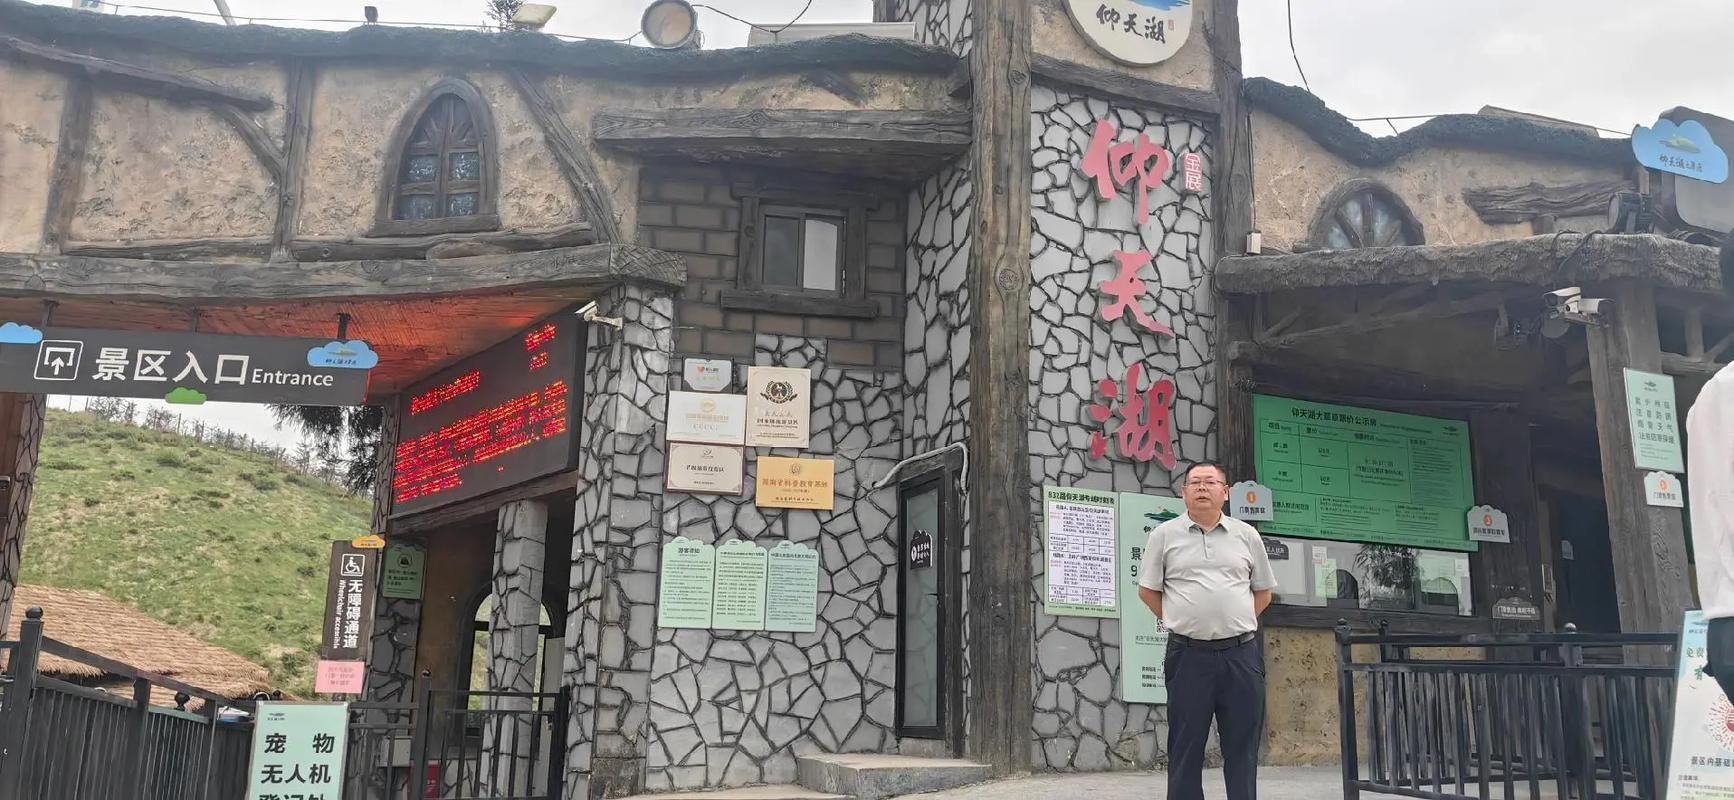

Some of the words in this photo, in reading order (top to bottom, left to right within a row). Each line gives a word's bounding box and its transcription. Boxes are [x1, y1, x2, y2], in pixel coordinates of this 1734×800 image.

[1096, 4, 1166, 44] 仰天湖
[1080, 118, 1177, 471] 仰天湖
[91, 347, 250, 385] 景区入口
[251, 368, 334, 387] Entrance
[342, 579, 364, 649] 无障碍通道
[260, 763, 332, 784] 无人机
